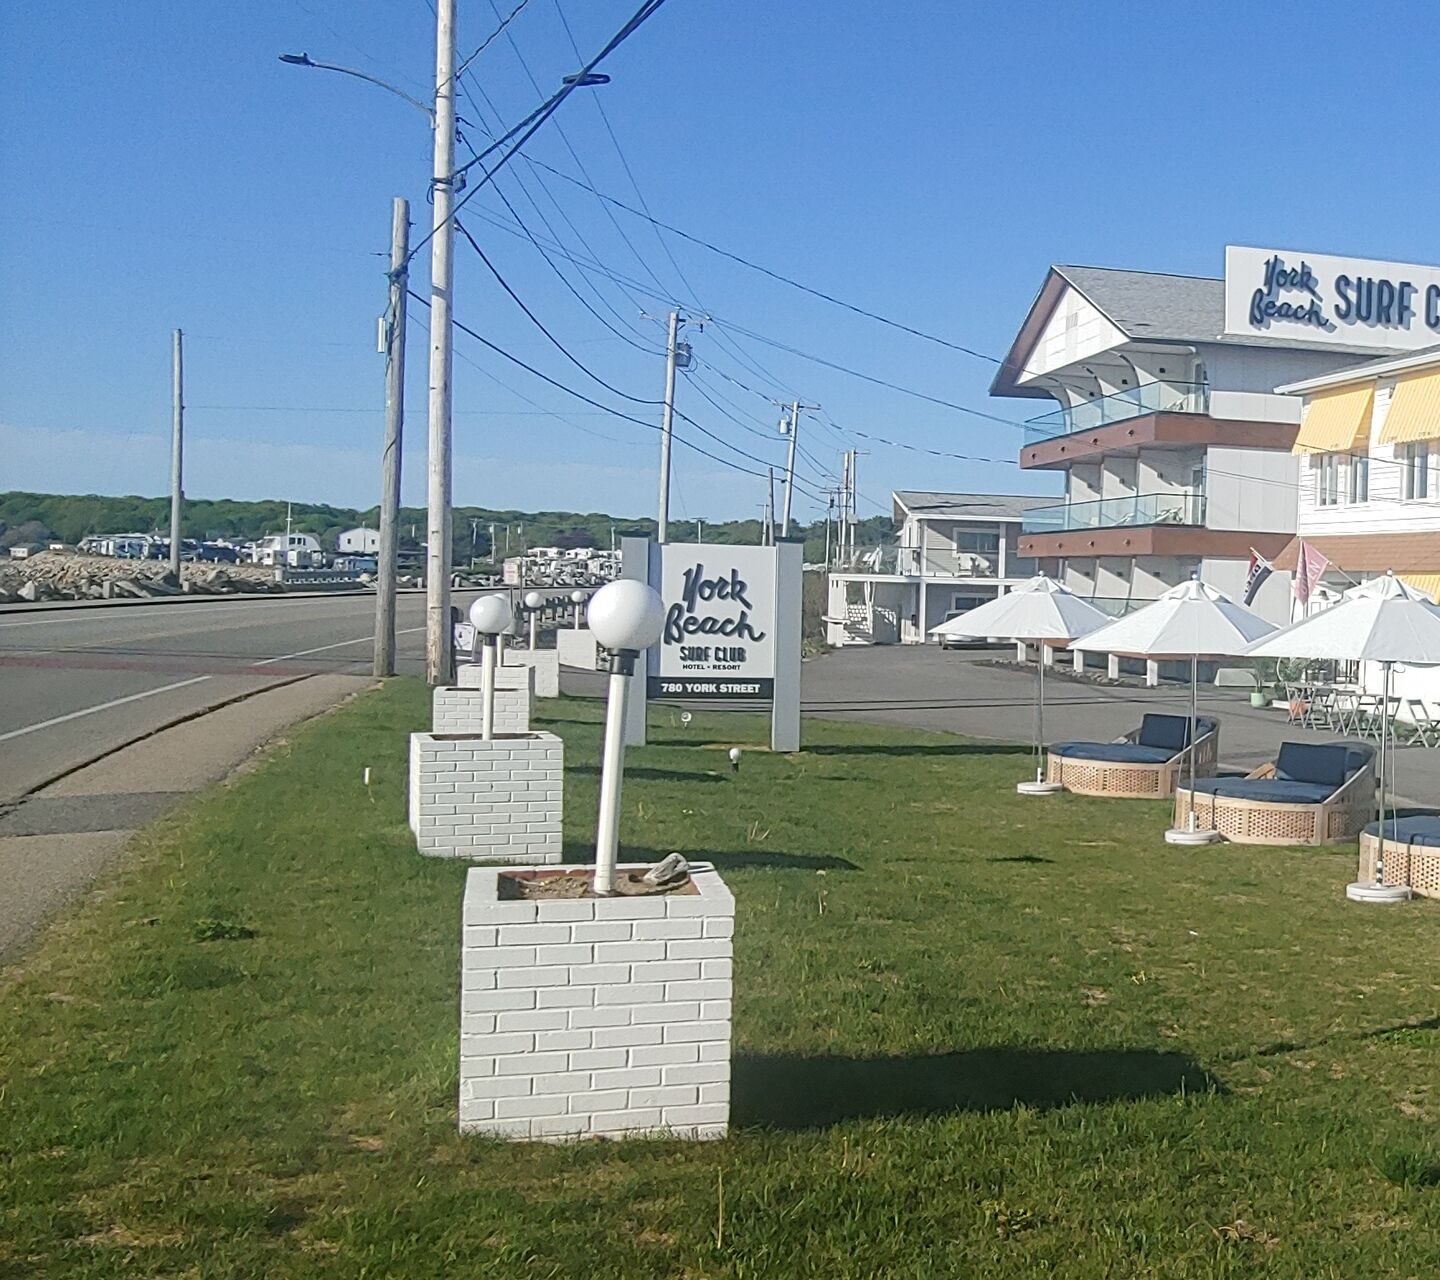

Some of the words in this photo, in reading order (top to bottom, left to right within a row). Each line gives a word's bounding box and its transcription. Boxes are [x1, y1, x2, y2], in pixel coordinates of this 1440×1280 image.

[1263, 255, 1323, 302] York
[1334, 274, 1416, 328] SURF
[1249, 288, 1337, 333] Beach
[682, 563, 753, 613] York
[663, 603, 766, 646] Beach
[679, 646, 712, 662] SURF
[714, 646, 747, 663] CLUB
[660, 682, 683, 693] 780
[685, 683, 718, 693] YORK
[719, 683, 761, 694] STREET
